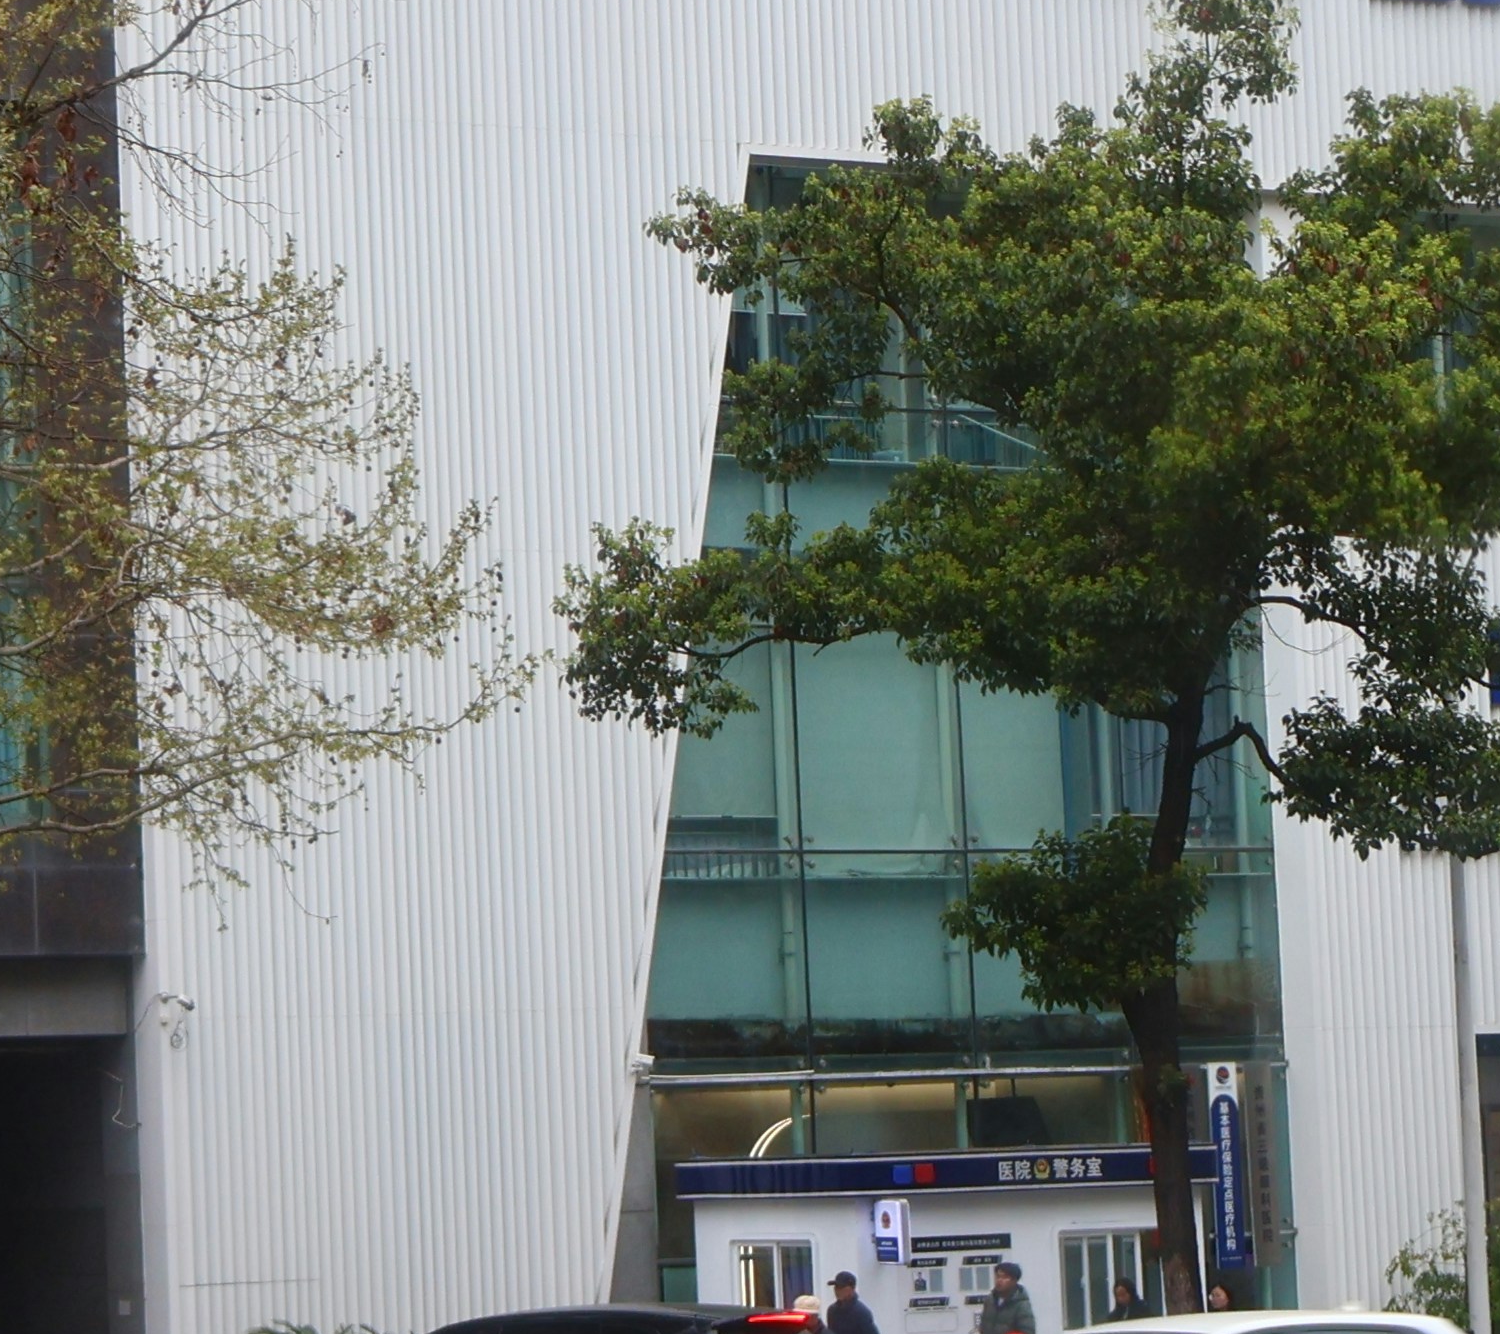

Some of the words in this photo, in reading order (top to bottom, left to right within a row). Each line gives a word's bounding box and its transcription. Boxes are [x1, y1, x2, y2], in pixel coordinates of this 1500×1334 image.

[998, 1161, 1032, 1181] 医院
[1052, 1158, 1103, 1178] 警务室
[1219, 1101, 1237, 1251] 基本医疗保险定点医疗机构
